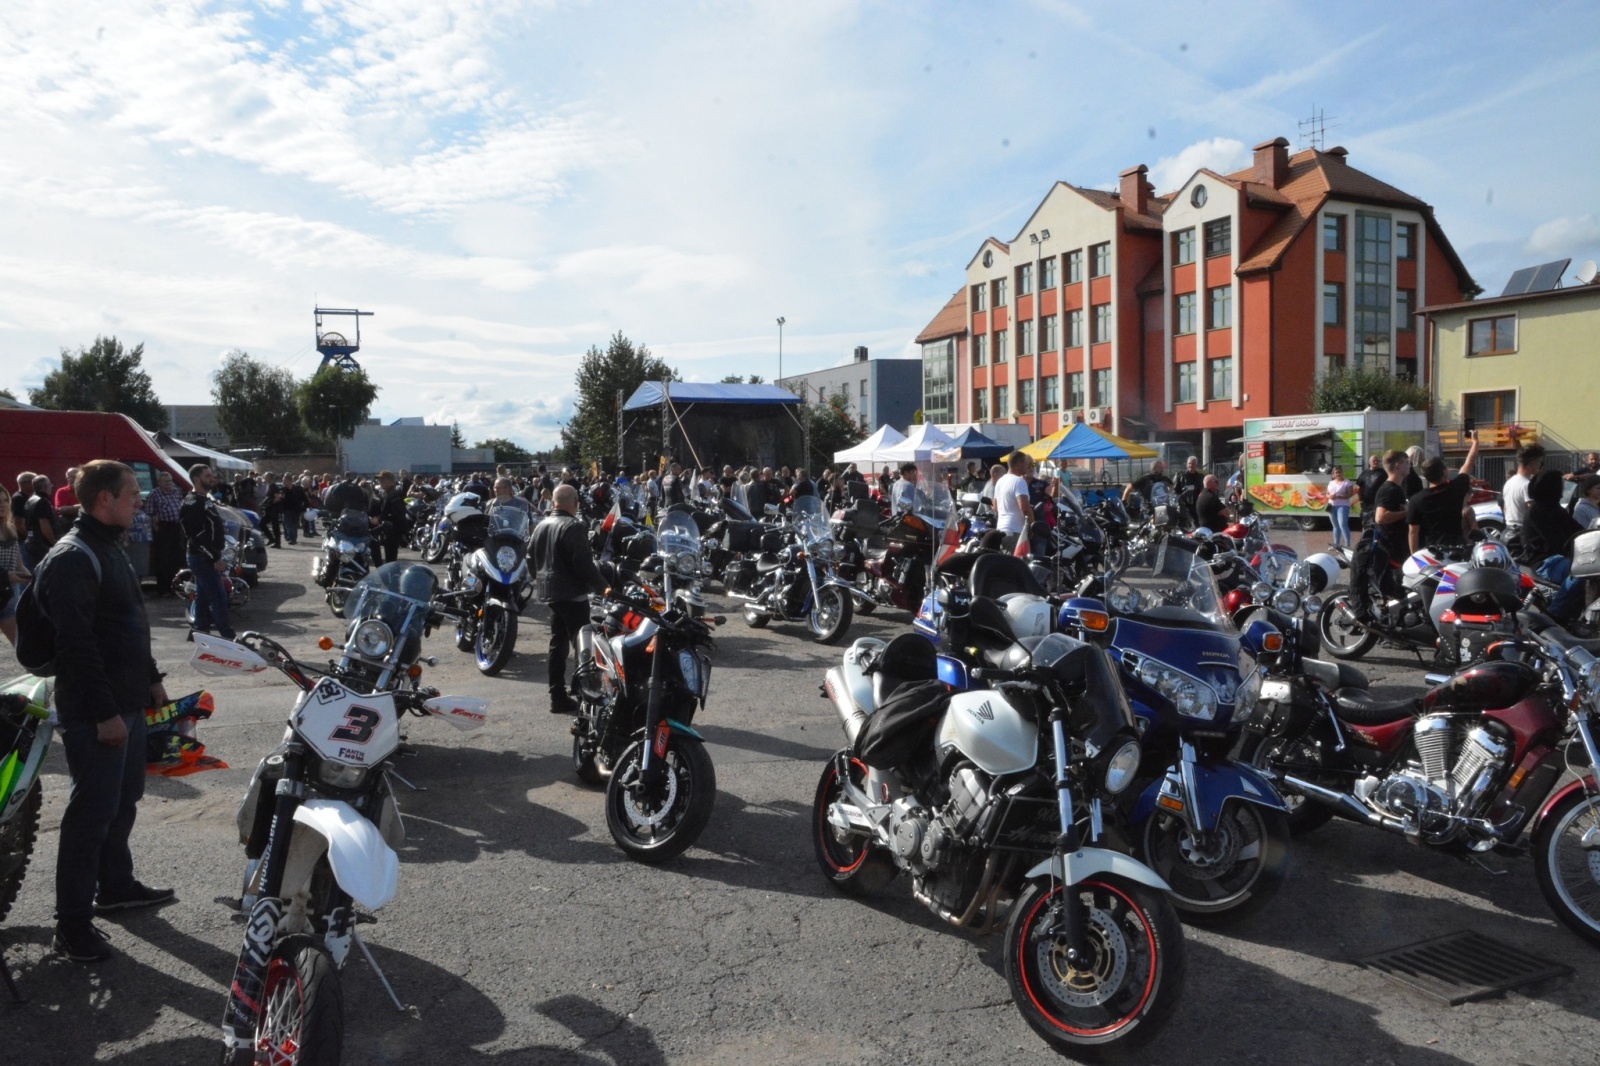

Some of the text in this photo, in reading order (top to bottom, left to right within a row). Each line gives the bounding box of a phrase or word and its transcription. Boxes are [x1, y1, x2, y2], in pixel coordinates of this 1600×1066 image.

[197, 652, 243, 668] FANTIC
[1202, 651, 1230, 659] HONDA
[451, 707, 485, 721] FANTIC
[966, 708, 985, 725] HONDA
[328, 703, 381, 746] 3
